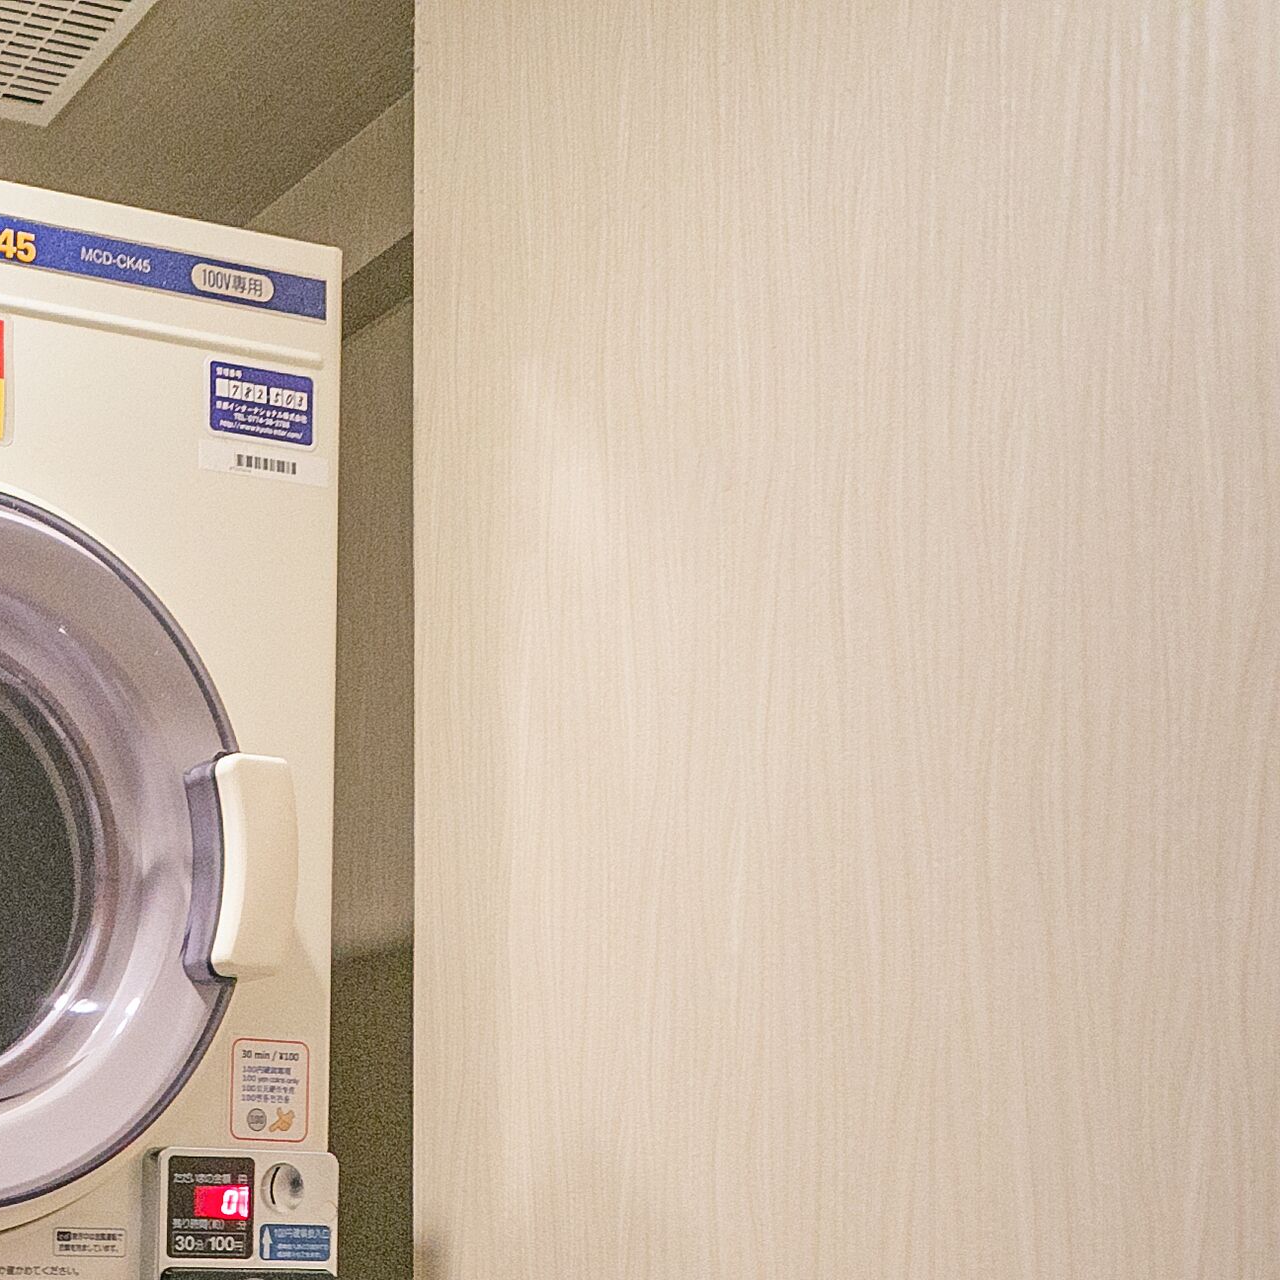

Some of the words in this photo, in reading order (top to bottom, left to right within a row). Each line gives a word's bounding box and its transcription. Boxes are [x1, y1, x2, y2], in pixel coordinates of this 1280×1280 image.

[80, 245, 151, 274] MCD-CK45
[242, 1050, 252, 1059] 30
[254, 1050, 270, 1059] min
